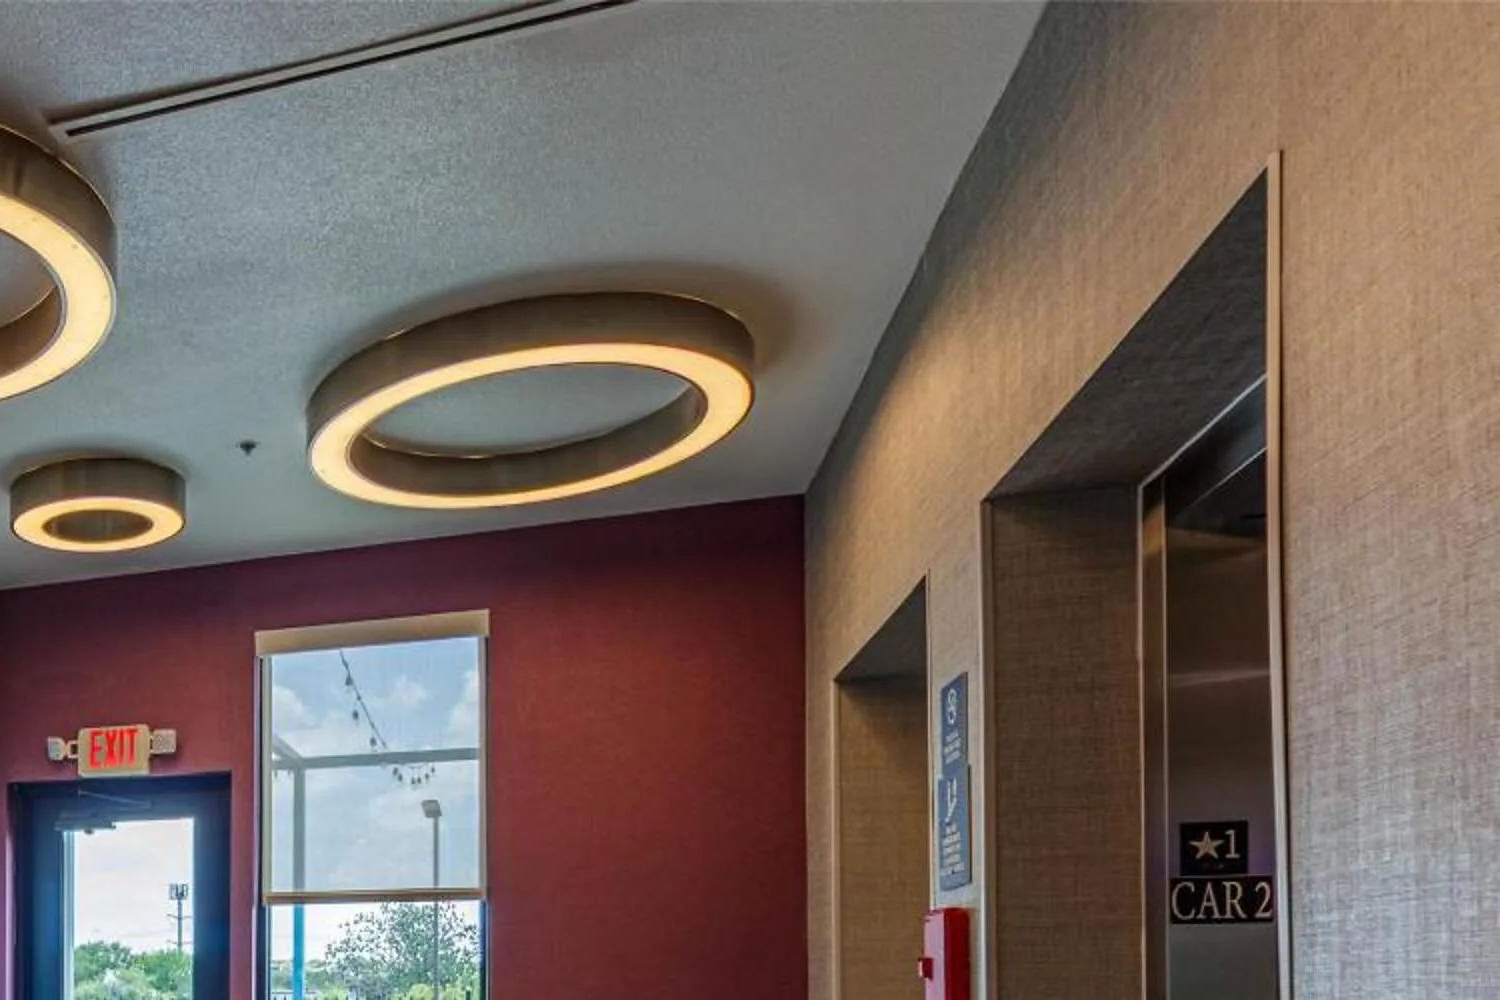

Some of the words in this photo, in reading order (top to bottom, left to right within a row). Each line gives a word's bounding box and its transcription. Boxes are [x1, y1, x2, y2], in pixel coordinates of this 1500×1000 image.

[90, 728, 140, 769] EXIT
[1225, 829, 1241, 859] 1
[1171, 881, 1247, 920] CAR
[1254, 881, 1273, 918] 2
